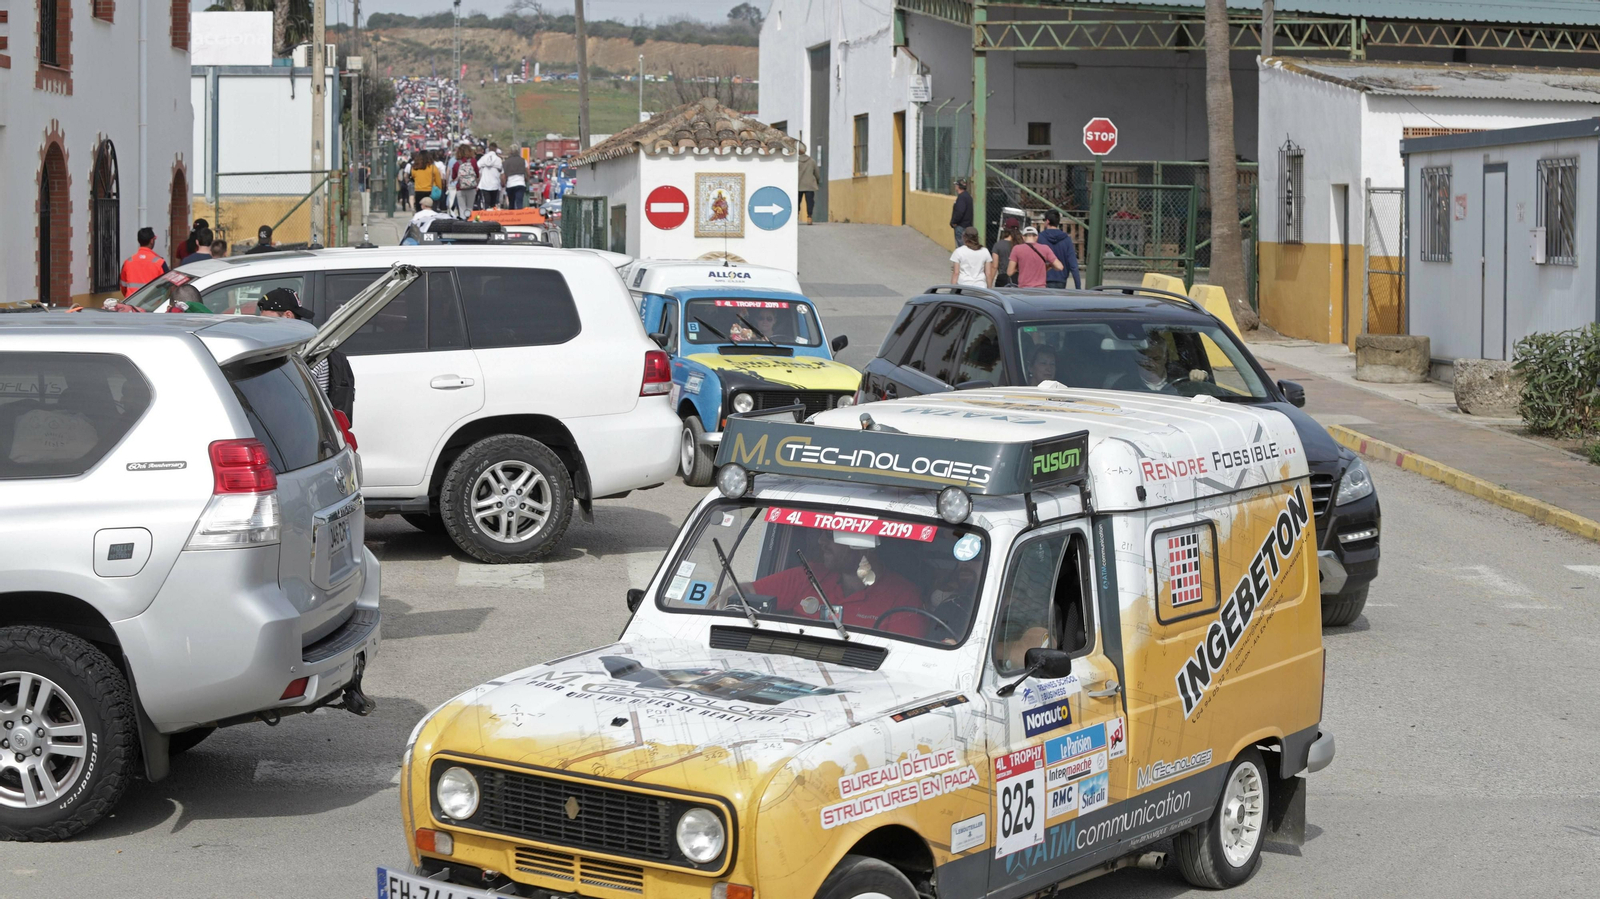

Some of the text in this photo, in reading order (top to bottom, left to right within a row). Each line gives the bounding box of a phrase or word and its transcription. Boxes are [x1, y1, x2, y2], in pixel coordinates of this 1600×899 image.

[1086, 131, 1115, 142] STOP
[708, 270, 752, 279] ALLOCA
[689, 323, 698, 331] B
[128, 461, 185, 471] 60th Anniversary
[786, 443, 993, 484] TECHNOLOGIES
[1033, 448, 1080, 475] FUSION
[1141, 457, 1208, 482] RENDRE
[1211, 442, 1279, 470] POSSIBLE
[541, 475, 562, 540] BFGoodrich
[786, 510, 913, 538] 4L TROPHY 2019
[688, 583, 708, 602] B
[1177, 484, 1309, 716] INGEBETON
[1234, 650, 1251, 674] TOULON
[1259, 624, 1267, 635] EN
[1044, 687, 1067, 701] BUSINESS
[1056, 675, 1078, 688] SCHOOL
[526, 680, 566, 692] POUR
[565, 690, 595, 700] QUE
[598, 694, 627, 703] VOS
[676, 705, 698, 713] SE
[1026, 705, 1069, 731] Norauto
[59, 732, 98, 810] BFGoodrich
[996, 745, 1042, 771] 4L TROPHY
[1048, 757, 1092, 782] Intermarché
[841, 750, 957, 795] BUREAU D'ÉTUDE
[823, 785, 919, 826] STRUCTURES
[921, 777, 941, 796] EN
[943, 768, 978, 790] PACA
[1001, 778, 1035, 839] 825
[1052, 786, 1074, 809] RMC
[1081, 788, 1106, 810] Sidi ali
